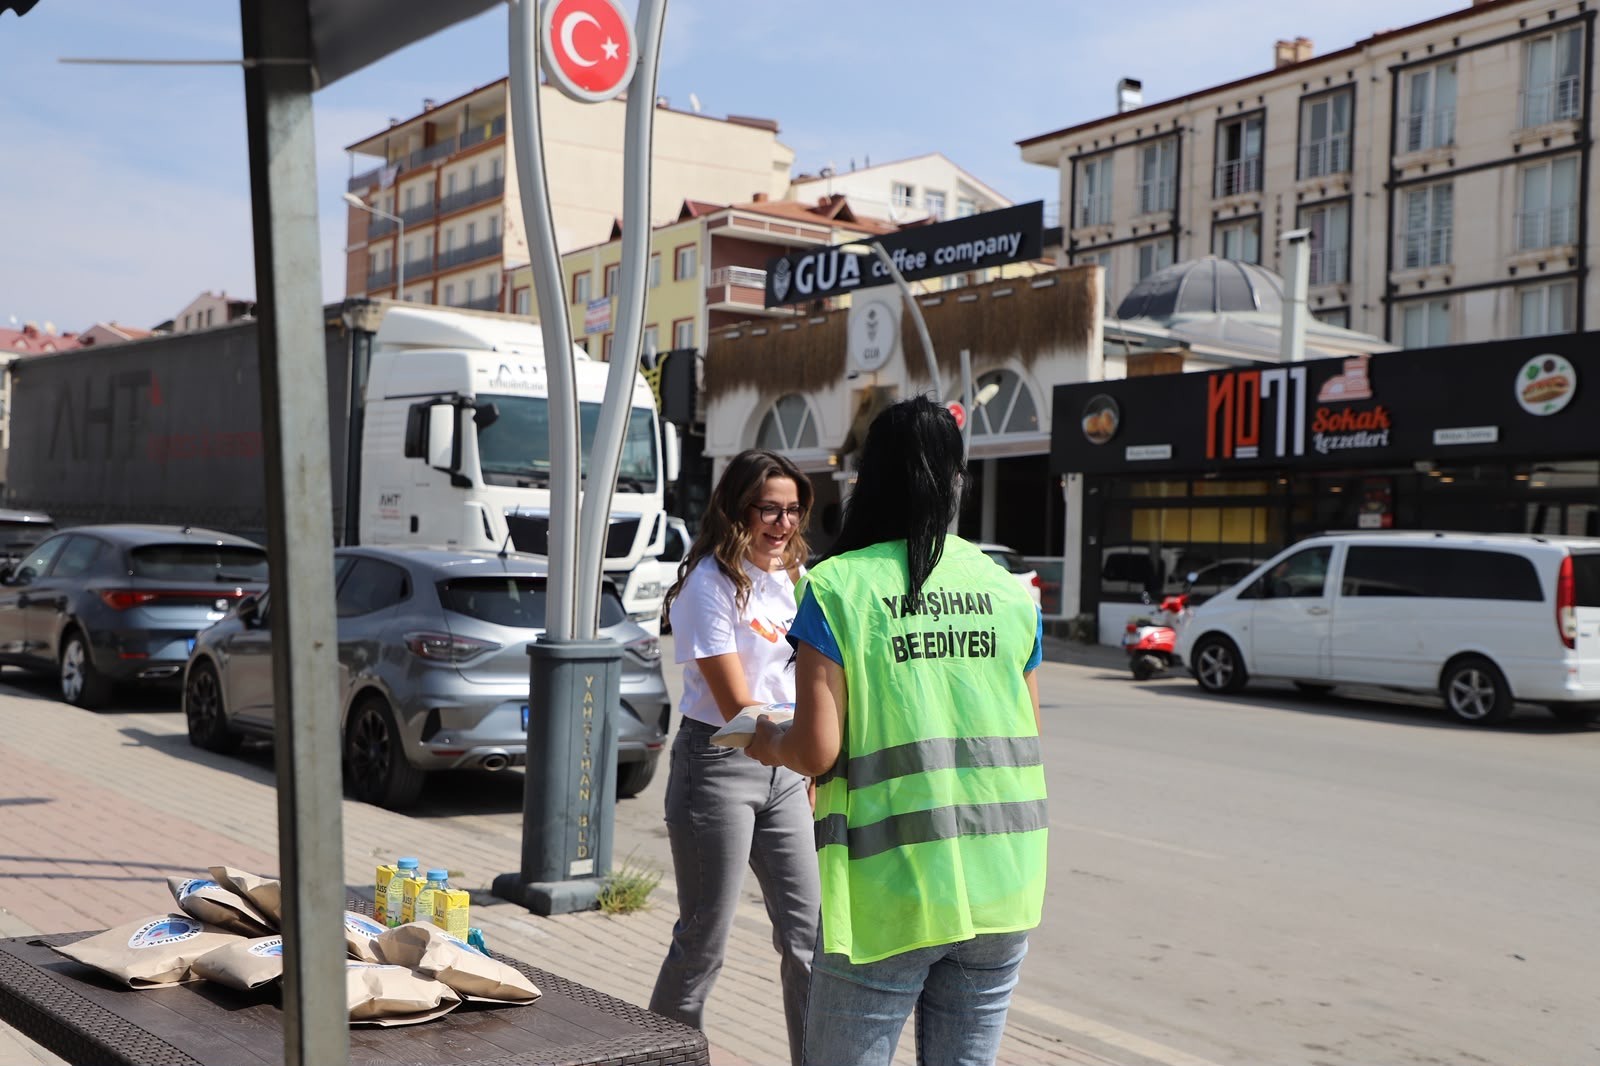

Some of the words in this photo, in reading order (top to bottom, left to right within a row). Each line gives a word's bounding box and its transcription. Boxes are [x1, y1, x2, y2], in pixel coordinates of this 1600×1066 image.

[795, 249, 860, 294] GUA
[933, 231, 1022, 264] company
[1312, 405, 1391, 433] Sokak
[1313, 429, 1389, 454] Lezzetleri
[891, 624, 996, 663] BEEDİYESİ
